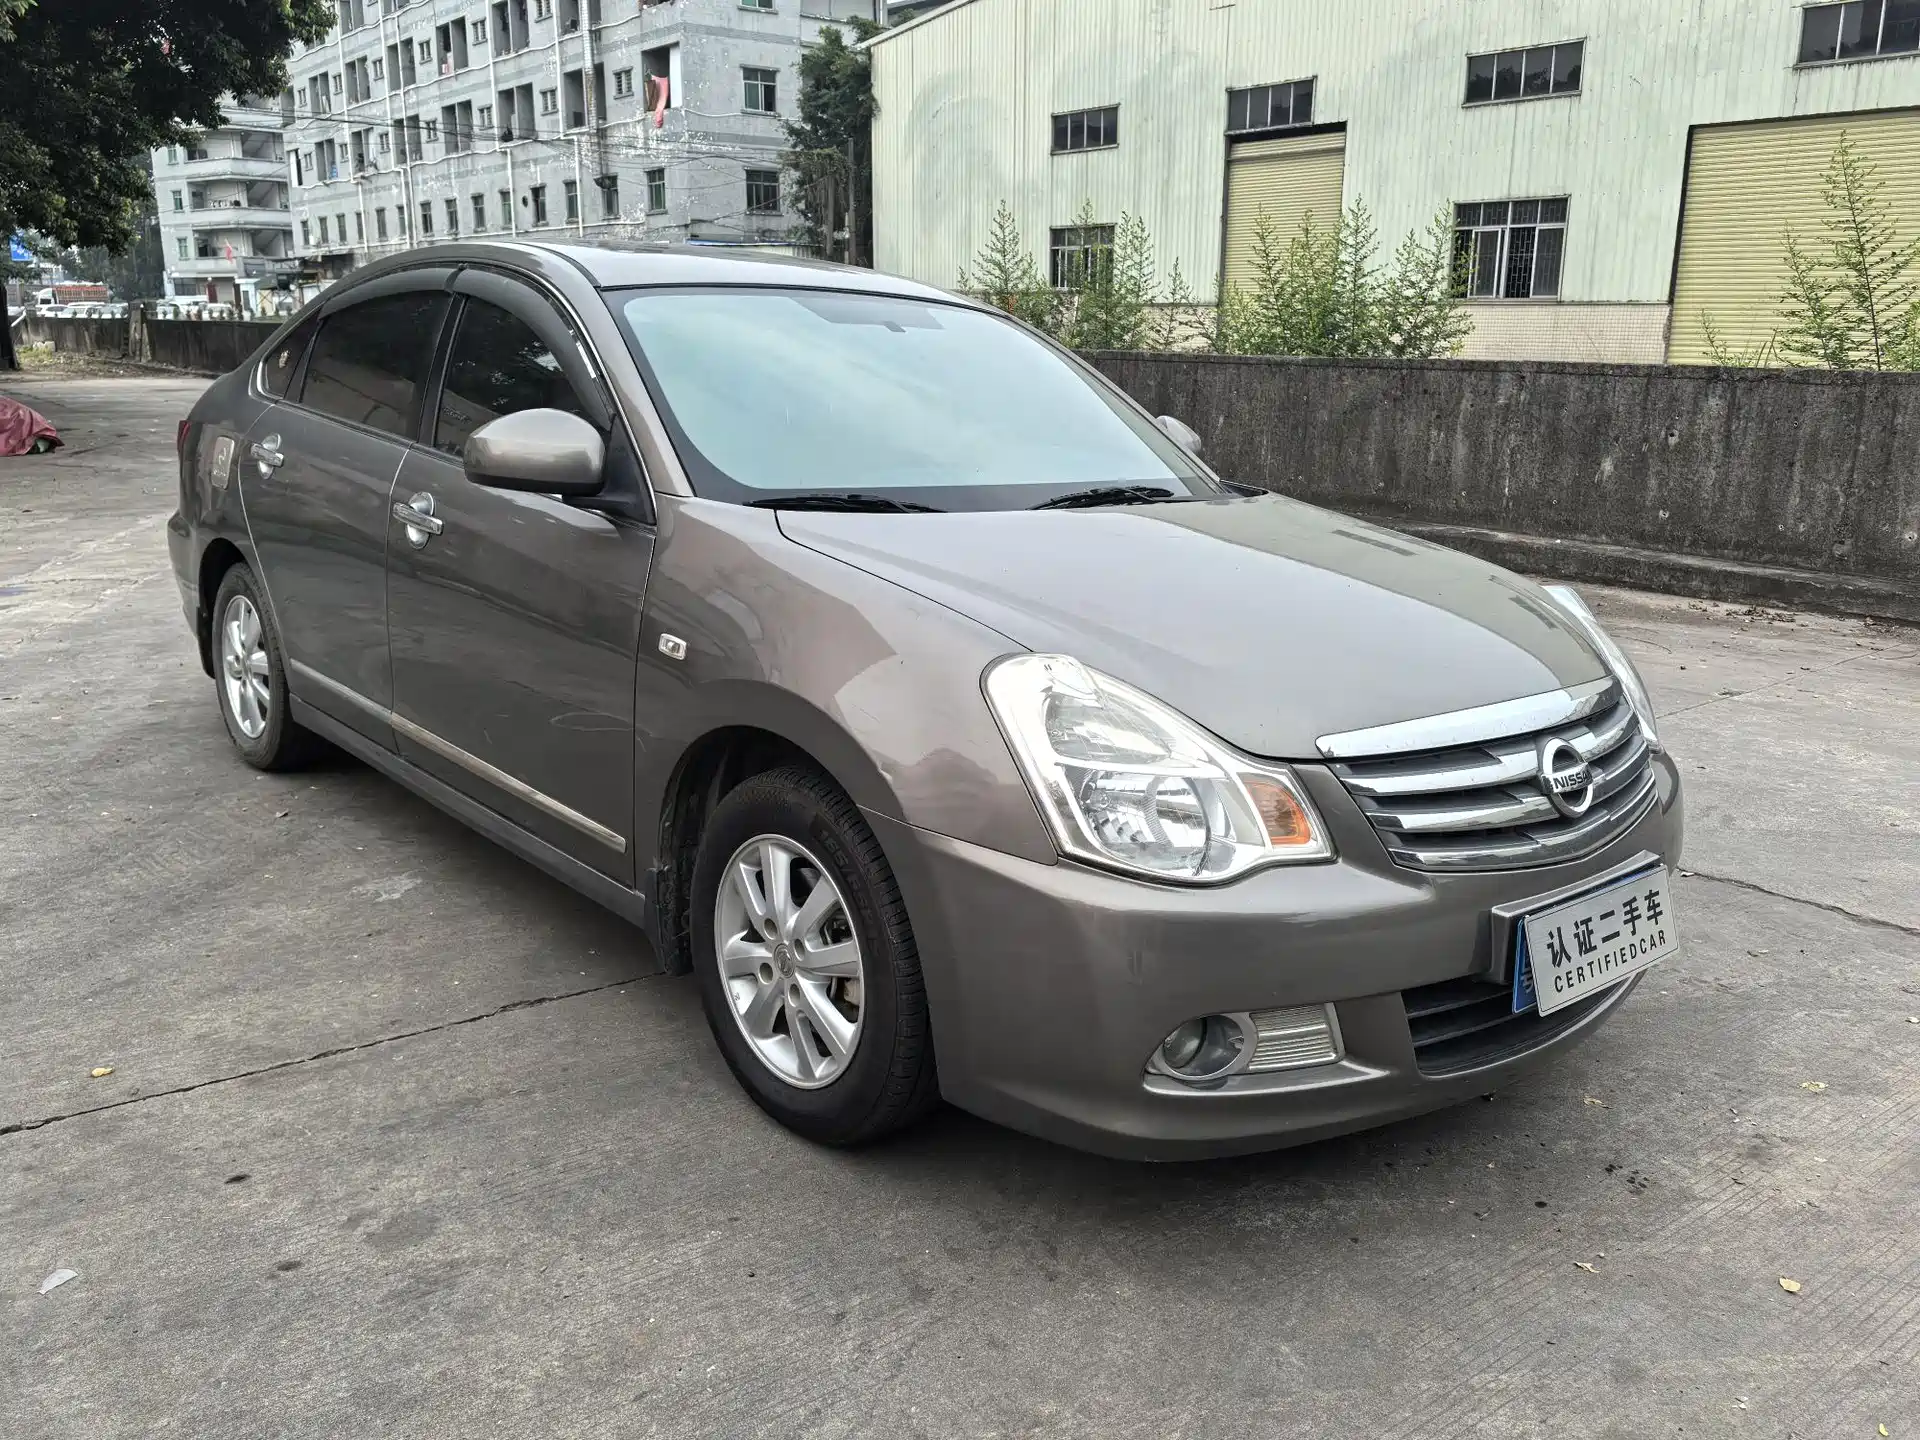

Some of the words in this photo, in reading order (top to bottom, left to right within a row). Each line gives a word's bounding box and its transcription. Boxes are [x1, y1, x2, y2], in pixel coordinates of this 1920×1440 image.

[1547, 889, 1663, 968] 认证二手车
[1554, 929, 1666, 993] CERTIFIEDCAR
